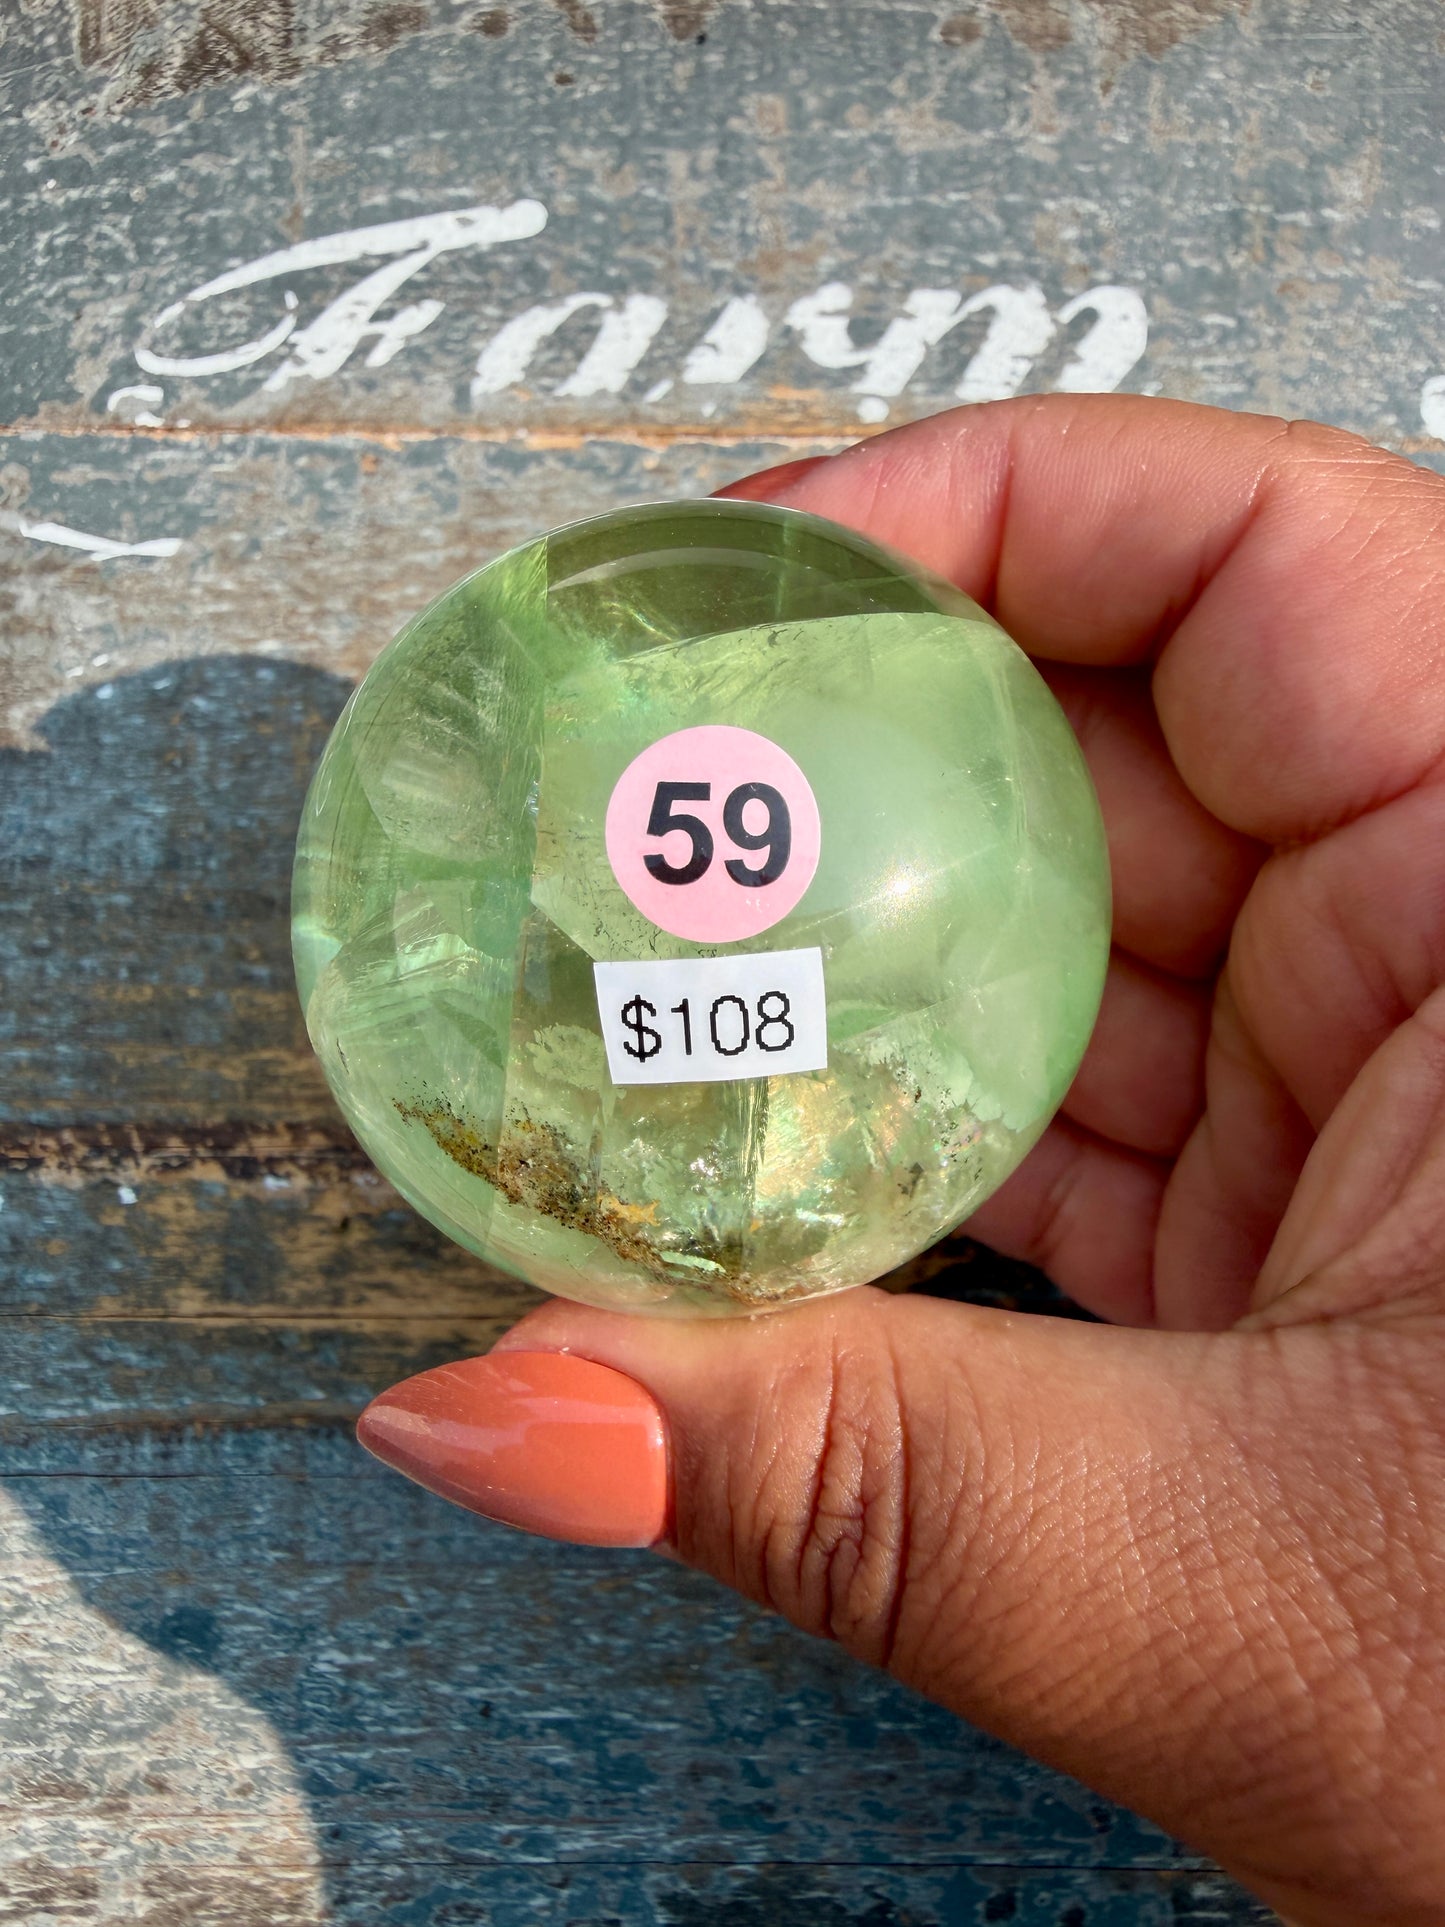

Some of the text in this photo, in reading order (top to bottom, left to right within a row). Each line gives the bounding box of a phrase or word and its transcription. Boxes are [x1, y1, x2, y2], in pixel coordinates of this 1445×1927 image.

[108, 199, 1150, 426] Farm
[643, 781, 792, 888] 59
[620, 990, 795, 1063] $108
